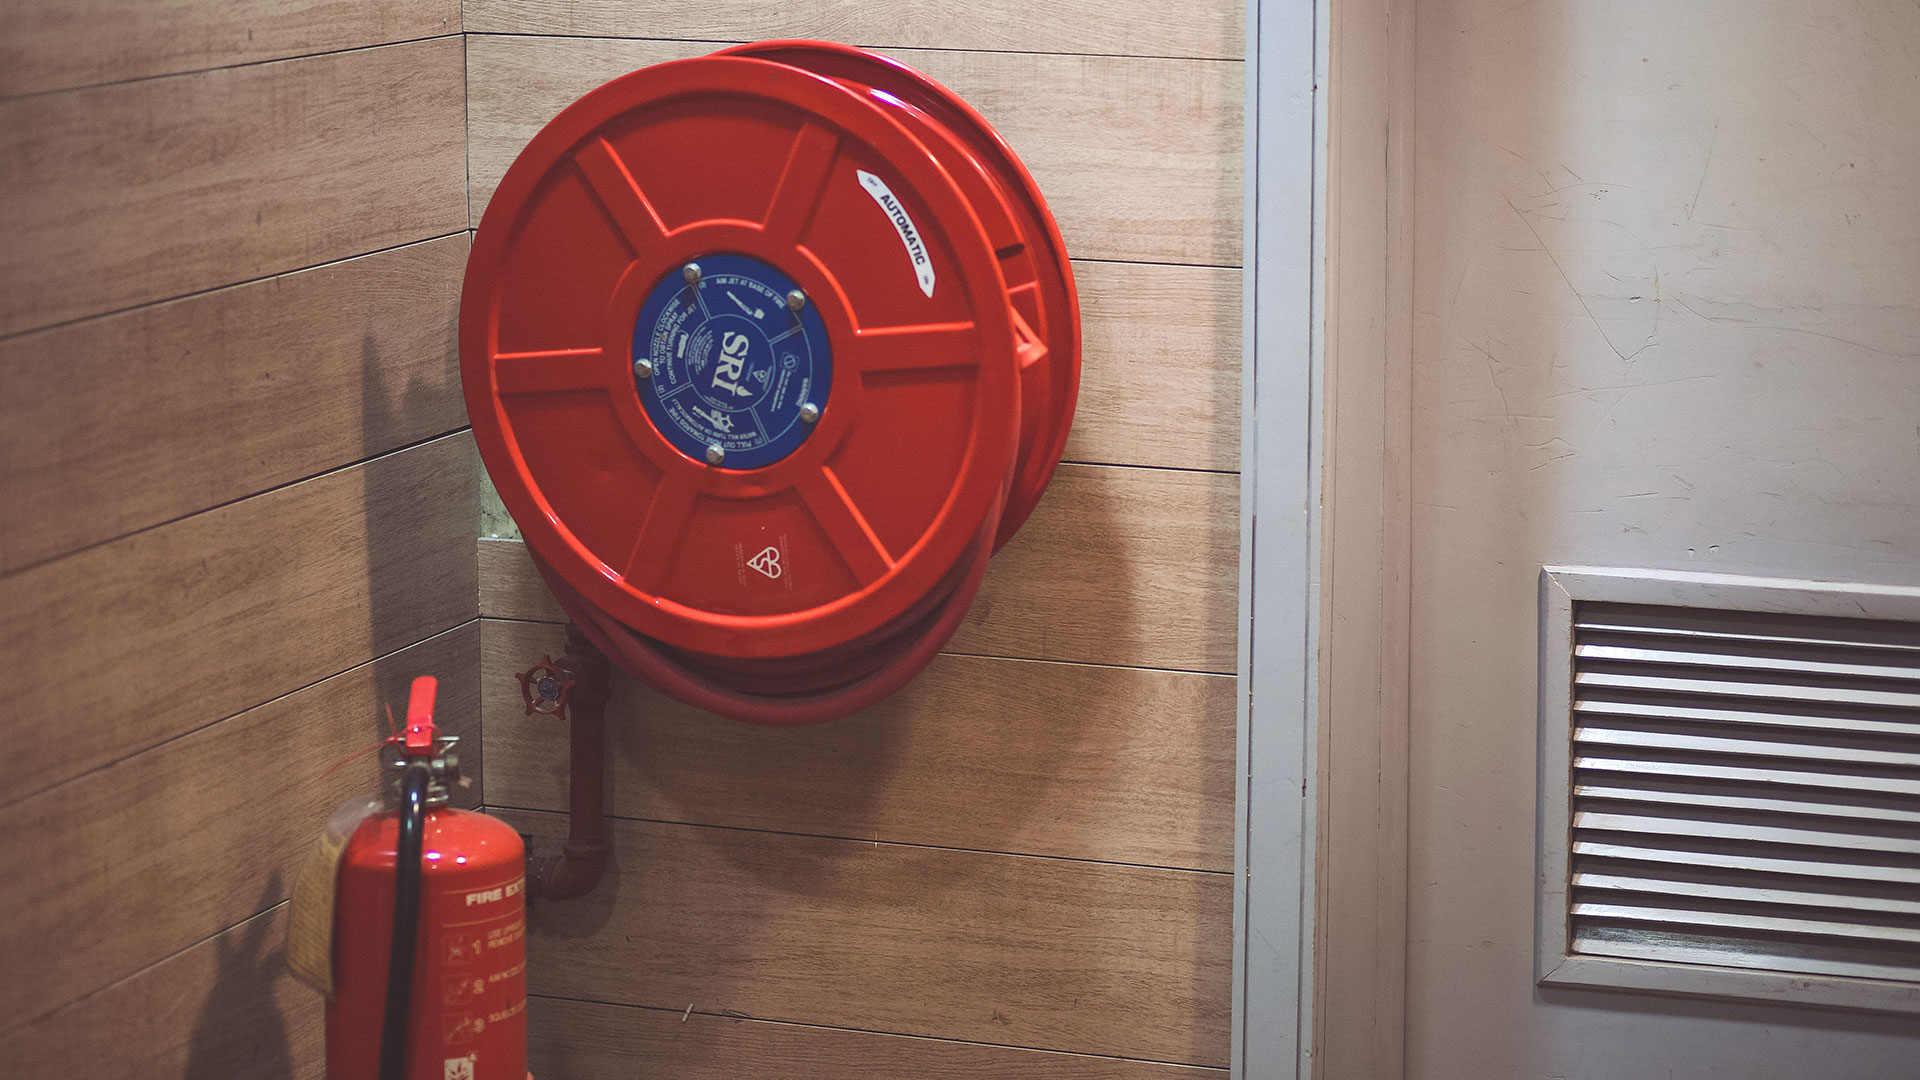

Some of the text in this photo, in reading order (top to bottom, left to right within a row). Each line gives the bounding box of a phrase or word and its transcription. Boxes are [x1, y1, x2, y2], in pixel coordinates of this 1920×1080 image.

[881, 194, 925, 265] AUTOMATIC
[748, 282, 765, 294] BASE
[764, 289, 773, 297] OF
[772, 295, 785, 309] FIRE
[657, 299, 680, 331] CLOCKWISE
[653, 331, 663, 357] NOZZLE
[660, 312, 678, 364] TO OBTAIN SPRAY
[666, 303, 696, 384] CONTINUE TURNING FOR JET
[670, 407, 681, 420] FIRE
[672, 399, 704, 431] AUTOMATICALLY
[680, 419, 705, 441] TOWARDS
[723, 441, 736, 449] OUT
[466, 888, 502, 906] FIRE
[472, 940, 481, 955] 1
[473, 980, 484, 994] 2
[473, 1019, 484, 1033] 3
